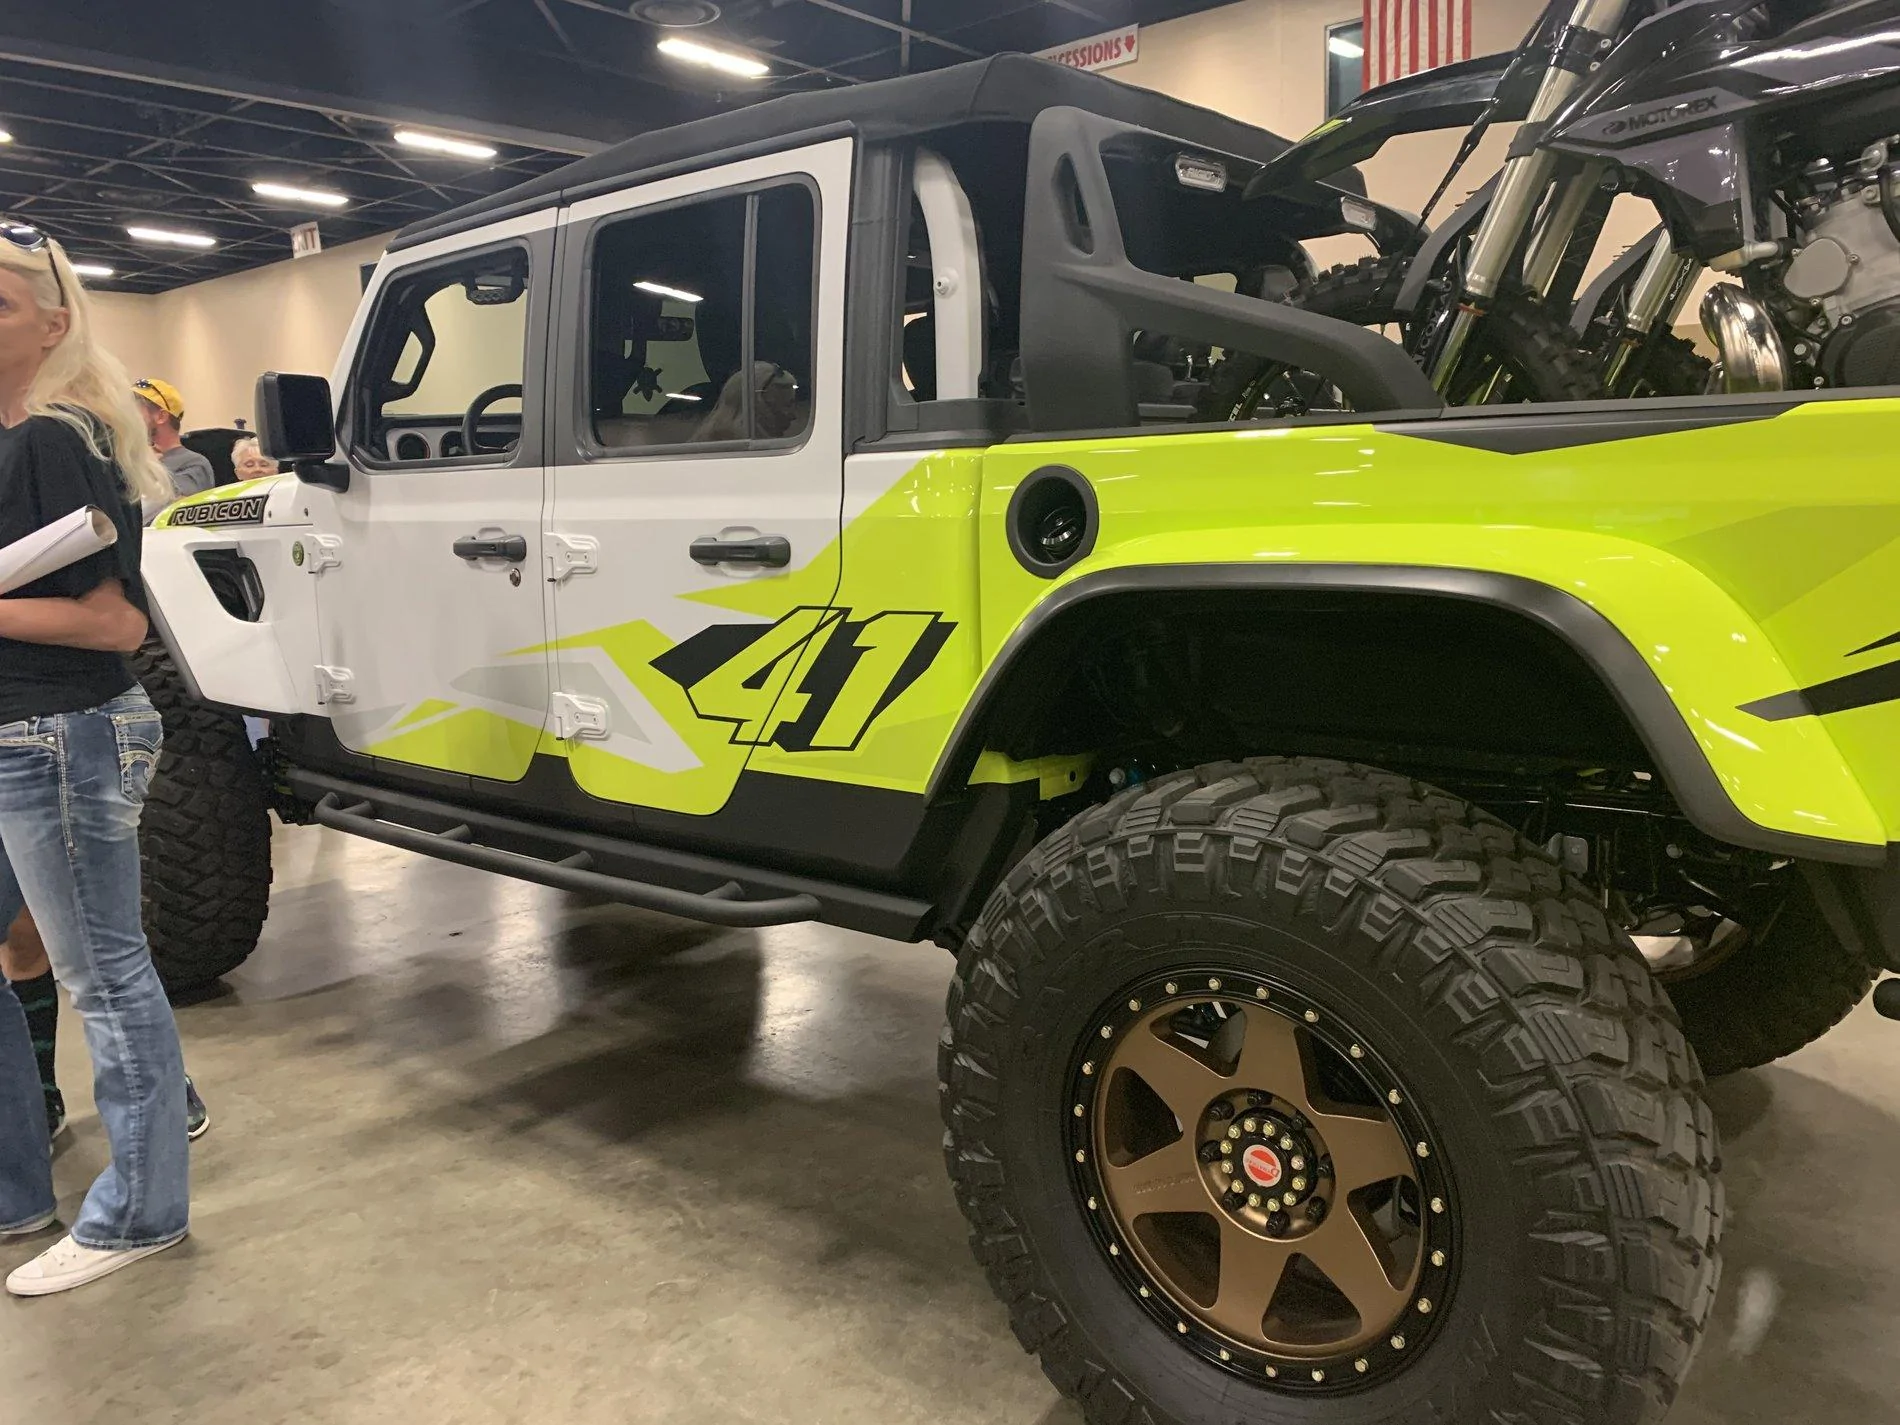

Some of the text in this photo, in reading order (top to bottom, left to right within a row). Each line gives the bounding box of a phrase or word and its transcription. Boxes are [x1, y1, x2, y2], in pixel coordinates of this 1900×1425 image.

[1628, 95, 1718, 131] MOTOREX
[171, 498, 263, 525] RUBICON
[672, 605, 954, 752] 41
